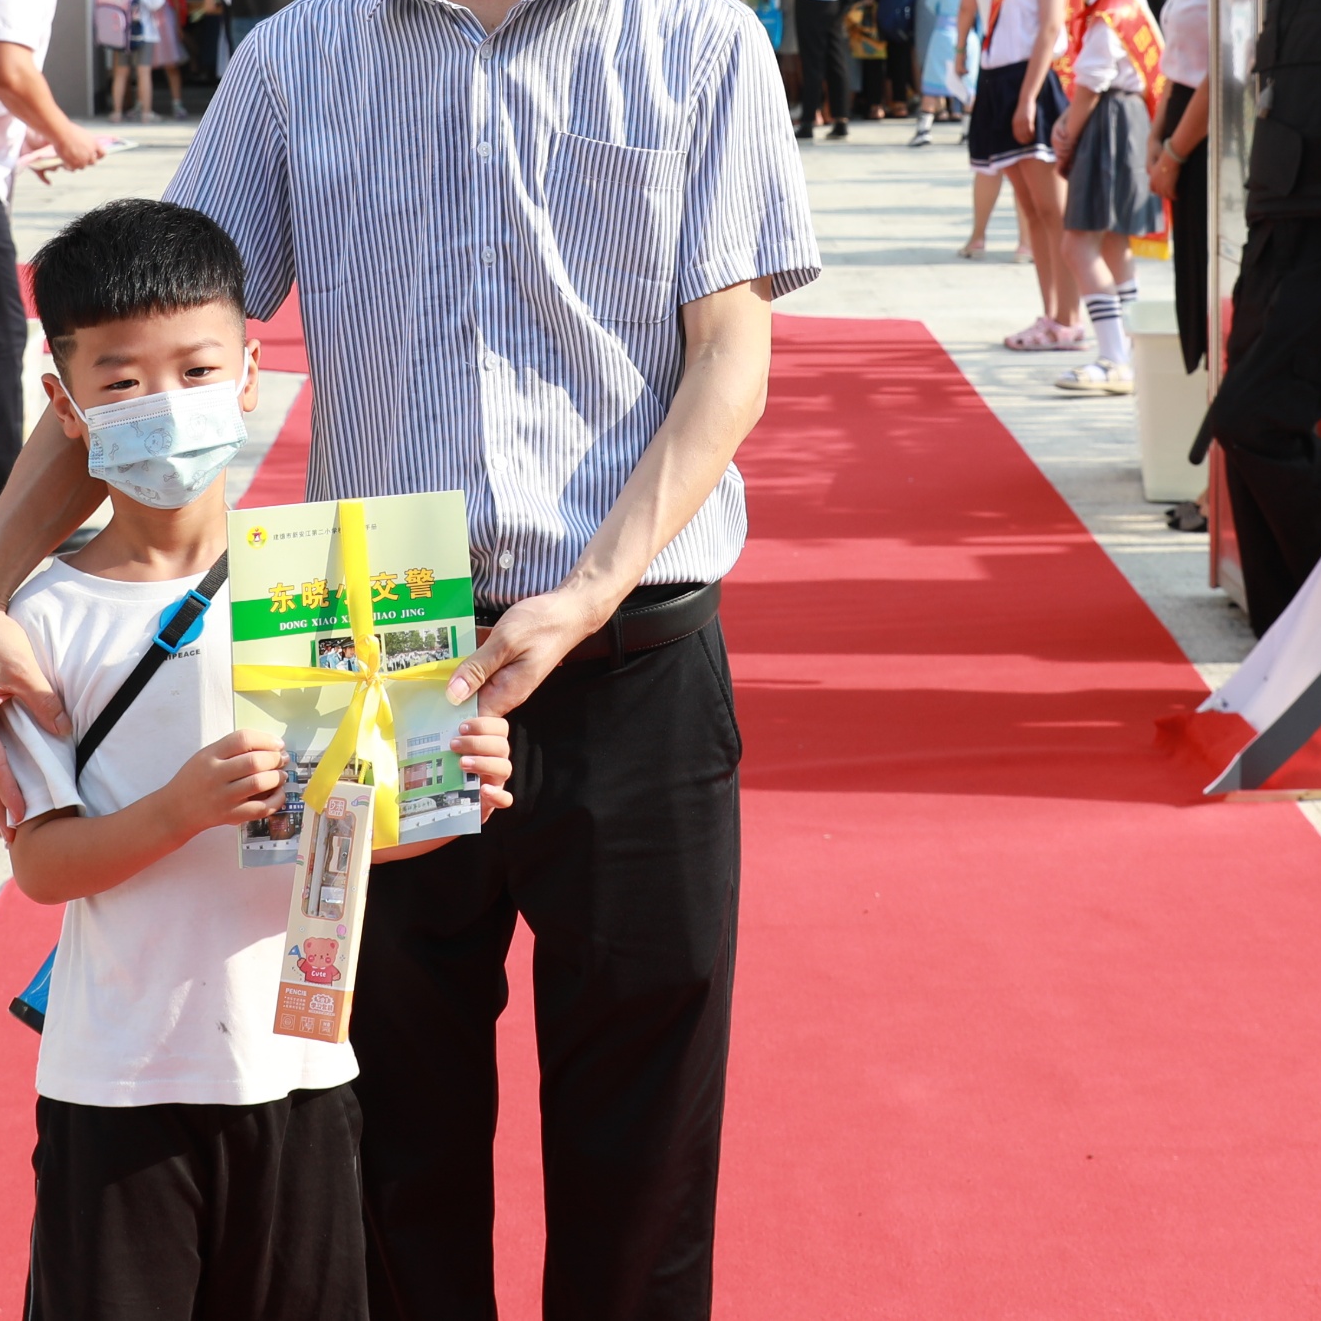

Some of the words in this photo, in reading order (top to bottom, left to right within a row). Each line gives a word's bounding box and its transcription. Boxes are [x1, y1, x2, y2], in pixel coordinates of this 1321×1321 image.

[279, 618, 307, 631] DONG
[311, 616, 337, 627] XIAO
[401, 607, 425, 619] JING
[311, 970, 327, 978] Cute
